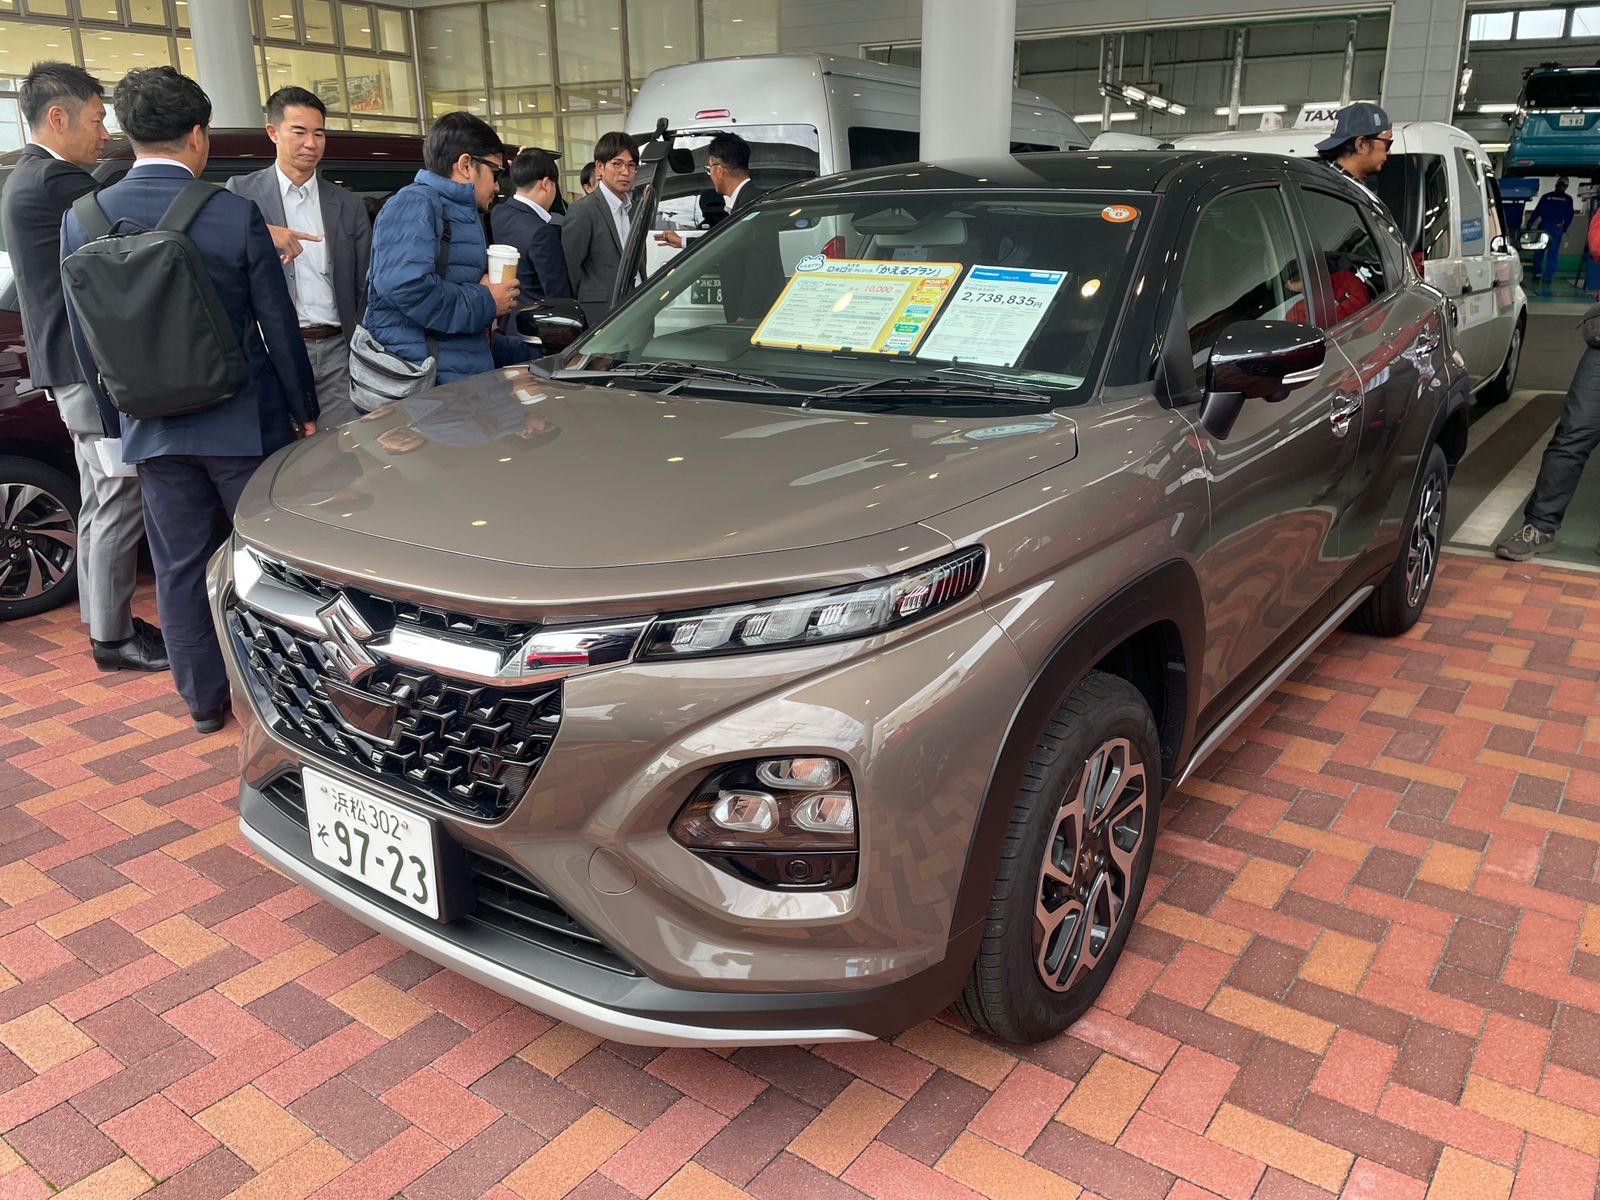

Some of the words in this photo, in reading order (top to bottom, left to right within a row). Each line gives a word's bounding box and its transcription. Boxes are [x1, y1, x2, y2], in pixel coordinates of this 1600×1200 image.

[1304, 110, 1337, 122] TAX
[316, 822, 330, 848] そ
[334, 820, 428, 905] 97-23
